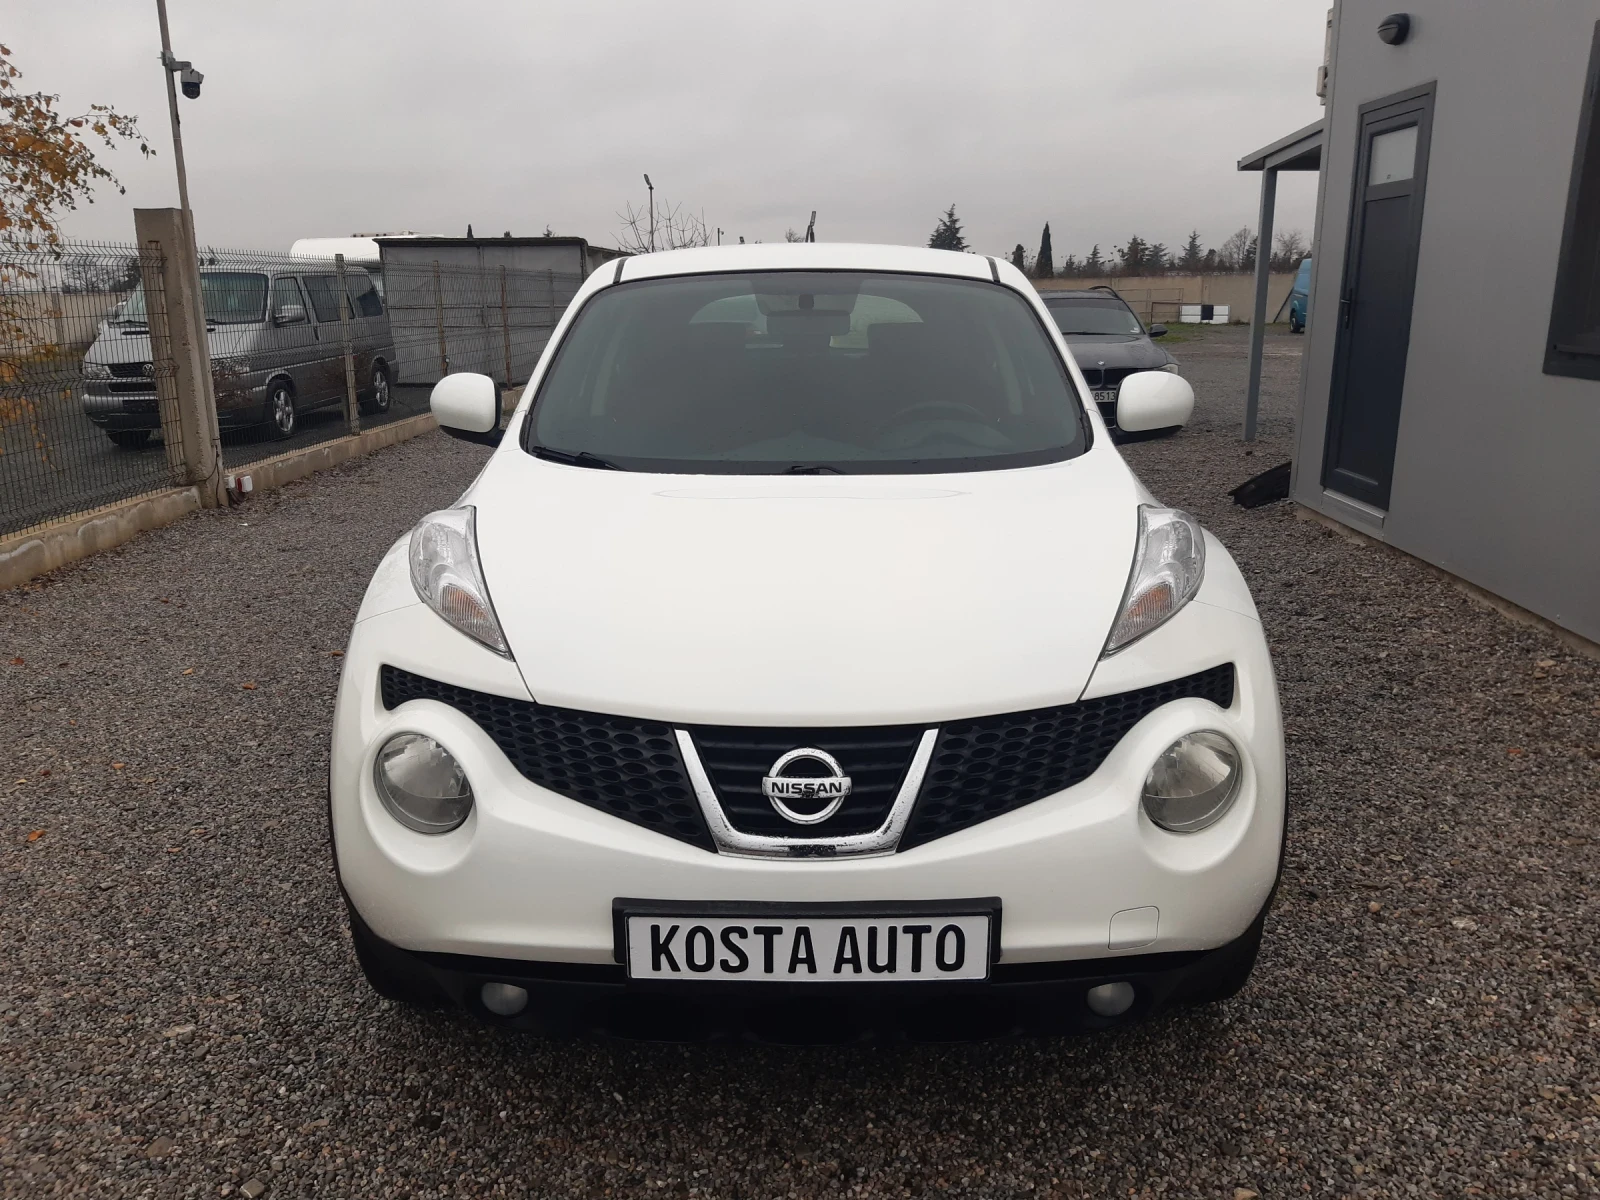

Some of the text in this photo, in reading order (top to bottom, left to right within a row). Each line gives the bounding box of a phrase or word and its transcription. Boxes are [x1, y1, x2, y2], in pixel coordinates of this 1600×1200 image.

[1094, 391, 1115, 401] 8513
[771, 782, 842, 795] NISSAN
[650, 924, 966, 974] KOSTA AUTO
